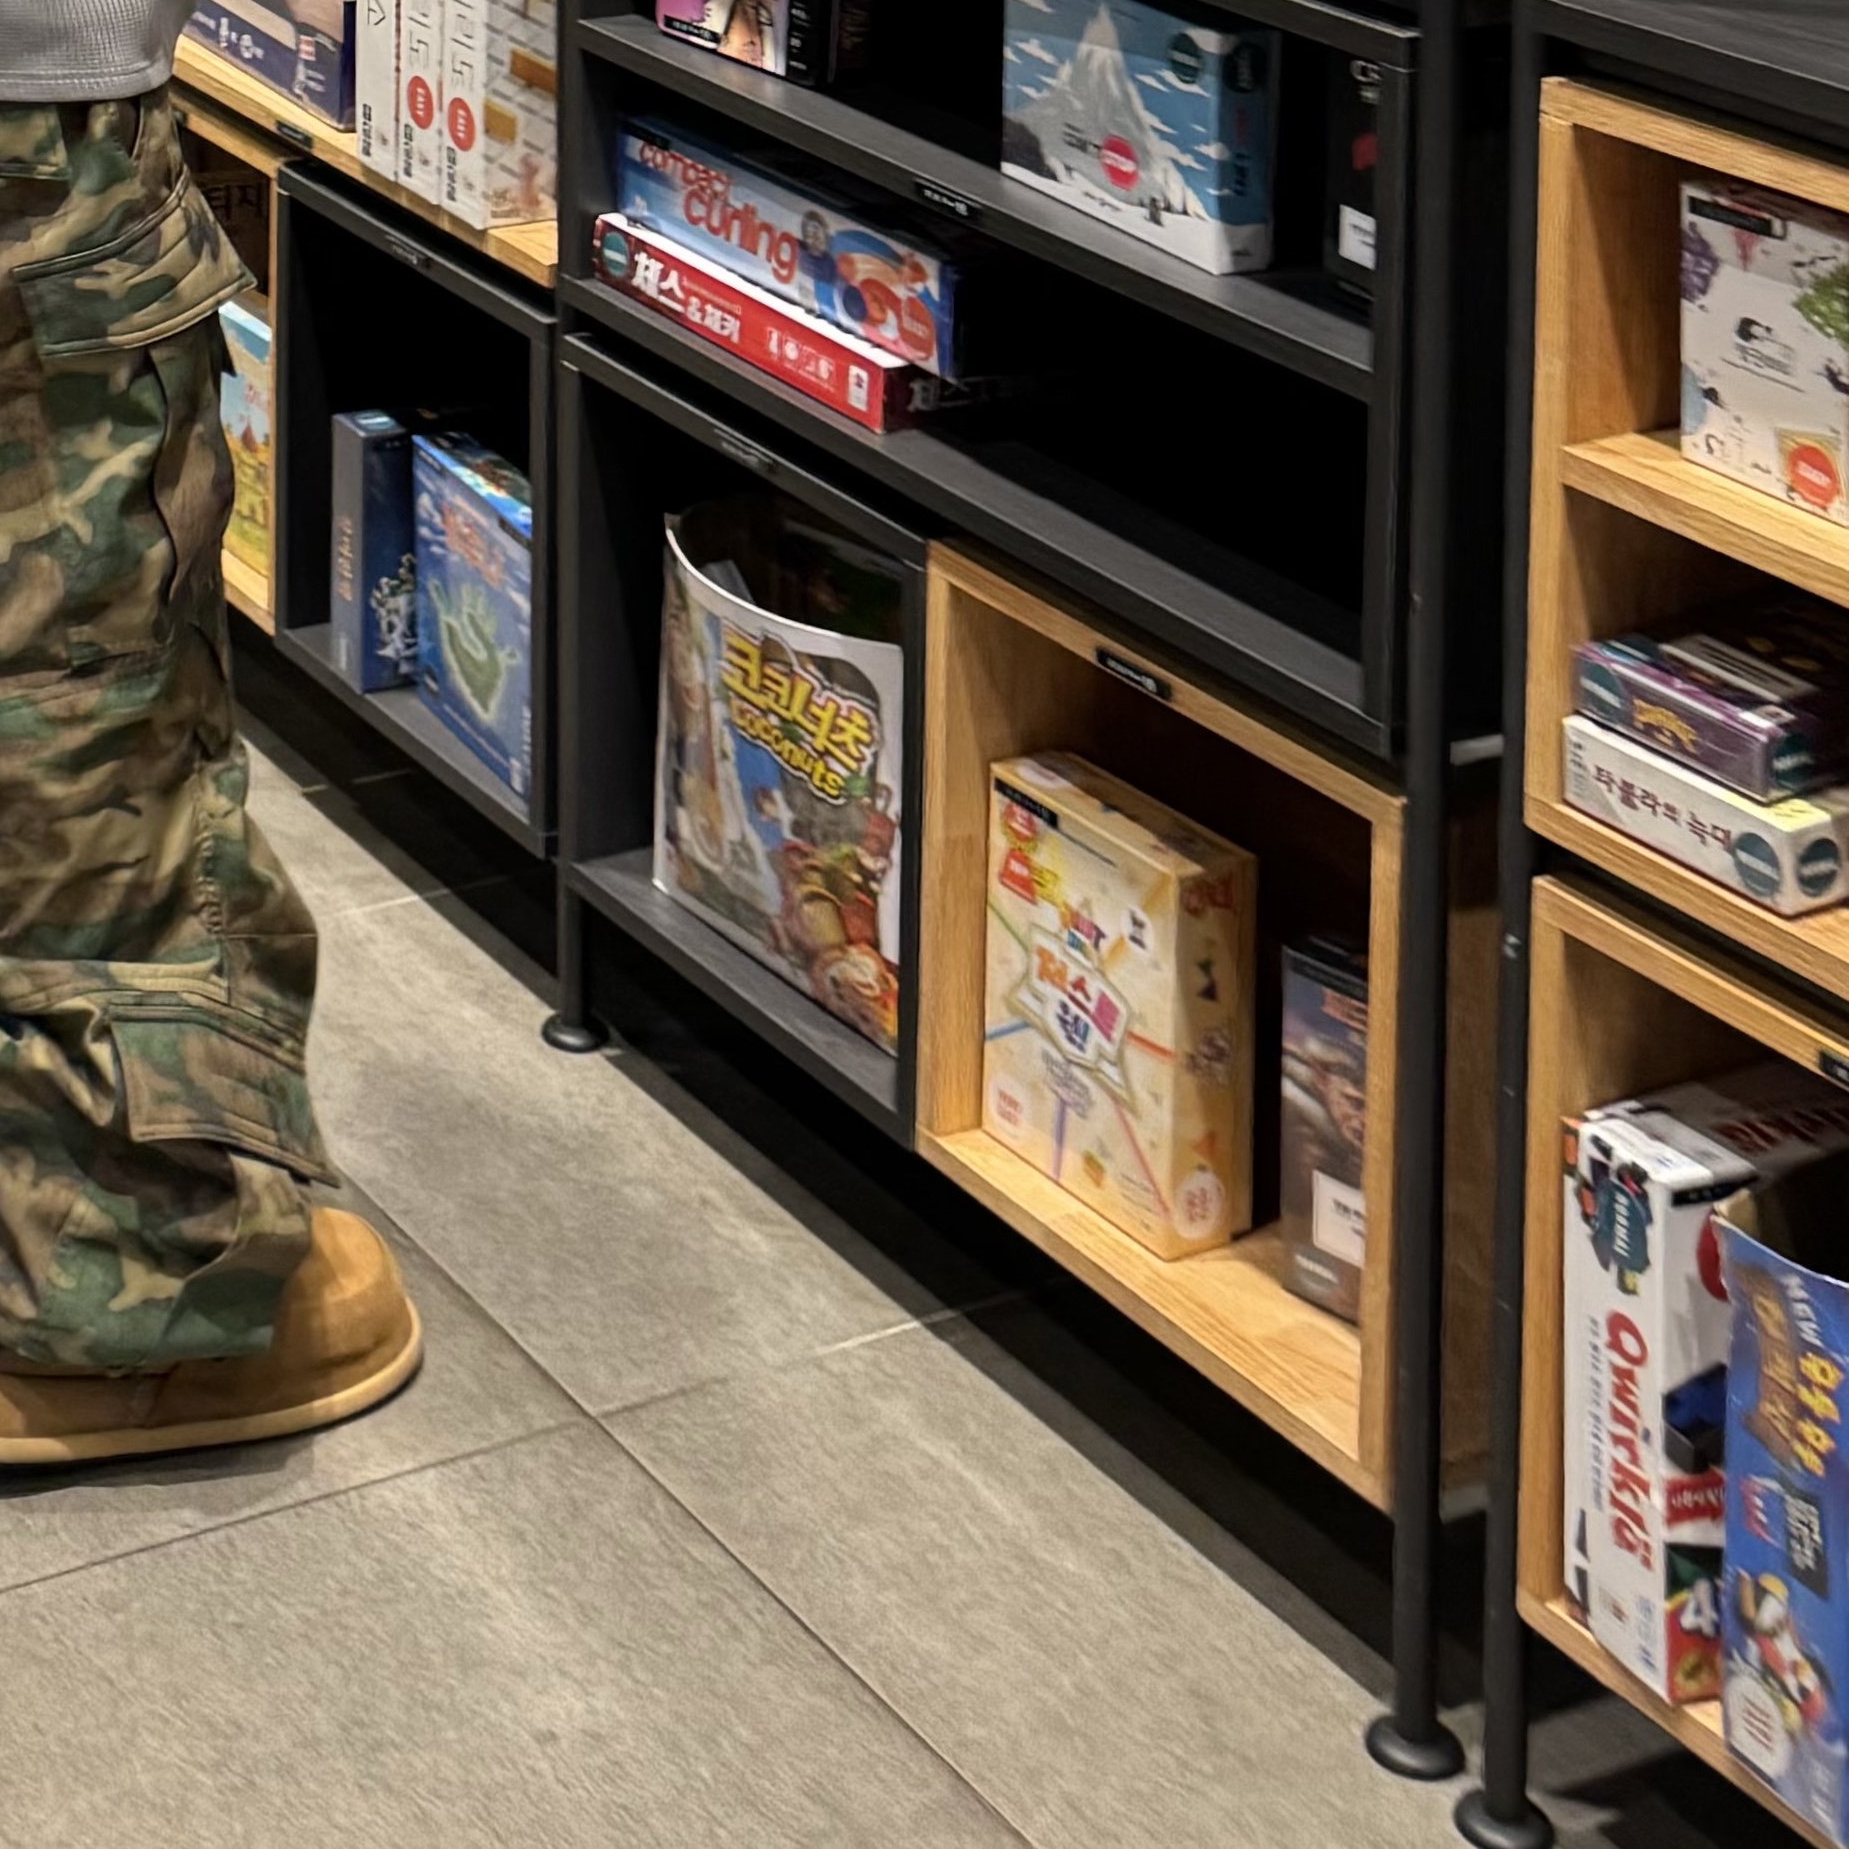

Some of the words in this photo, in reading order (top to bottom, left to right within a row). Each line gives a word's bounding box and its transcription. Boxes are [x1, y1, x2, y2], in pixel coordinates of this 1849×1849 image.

[682, 187, 800, 285] curling
[719, 617, 875, 774] 코코너츠
[1687, 811, 1732, 850] 늑대
